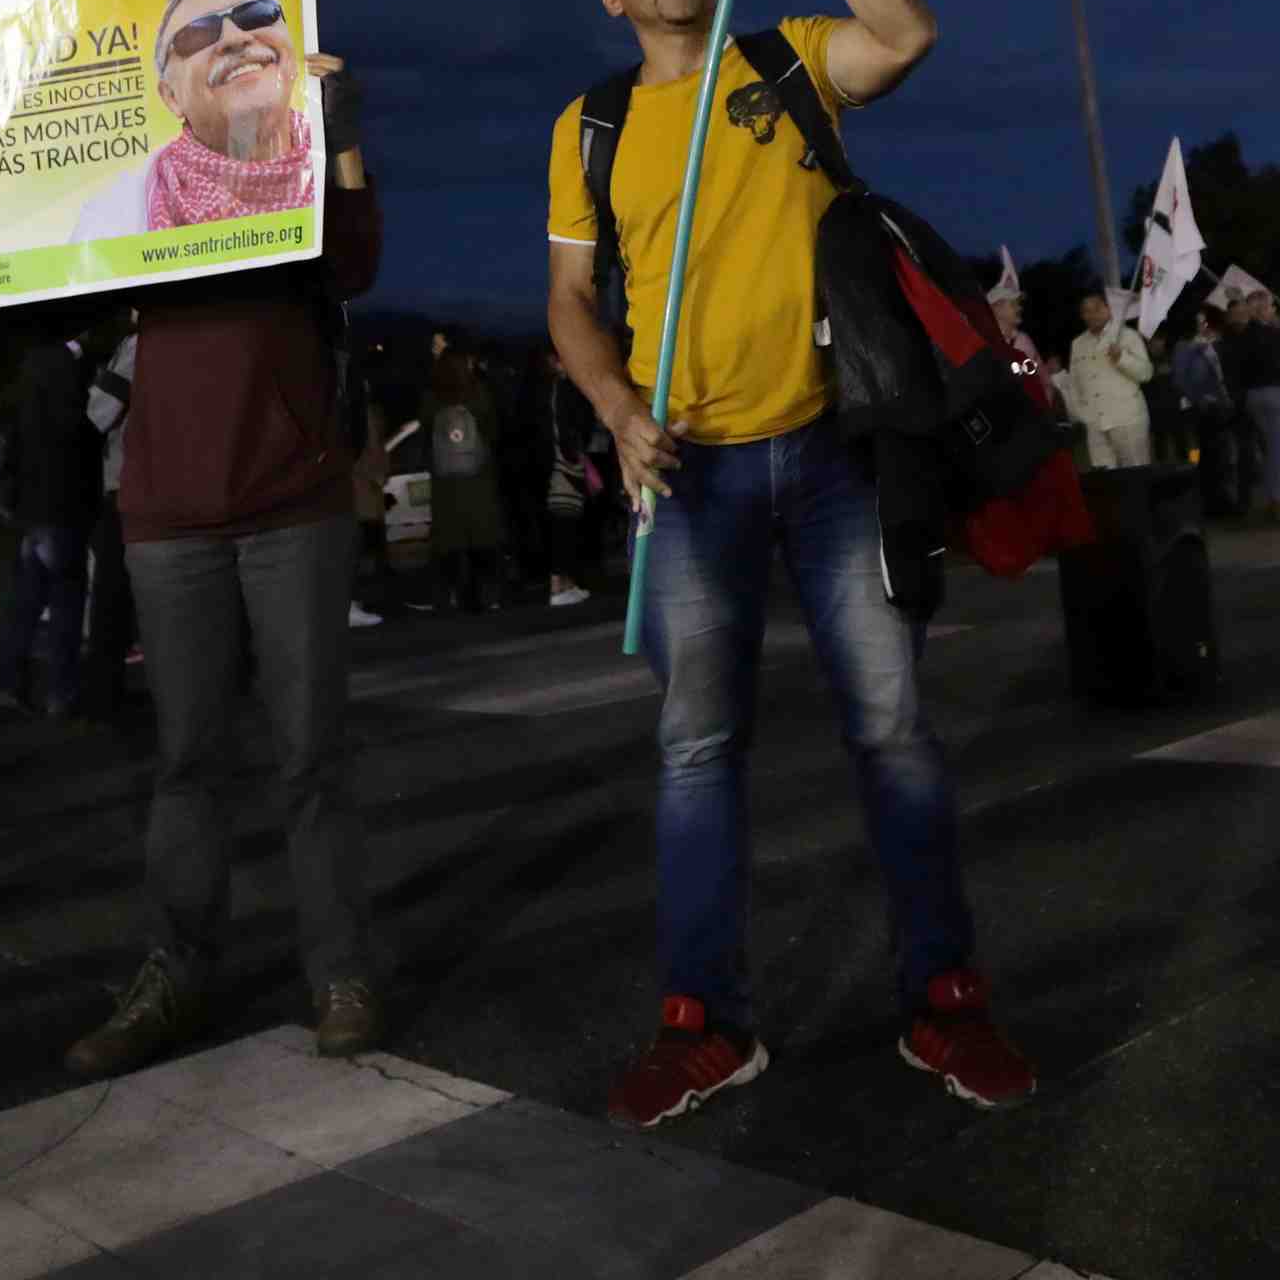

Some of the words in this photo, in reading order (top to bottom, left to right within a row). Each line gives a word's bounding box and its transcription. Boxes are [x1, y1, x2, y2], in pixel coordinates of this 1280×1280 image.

[88, 22, 140, 58] YA!
[23, 91, 45, 109] ES
[48, 74, 145, 106] INOCENTE
[23, 105, 146, 144] MONTAJES
[31, 132, 150, 171] TRAICIÓN
[142, 223, 304, 264] www.santrichlibre.org
